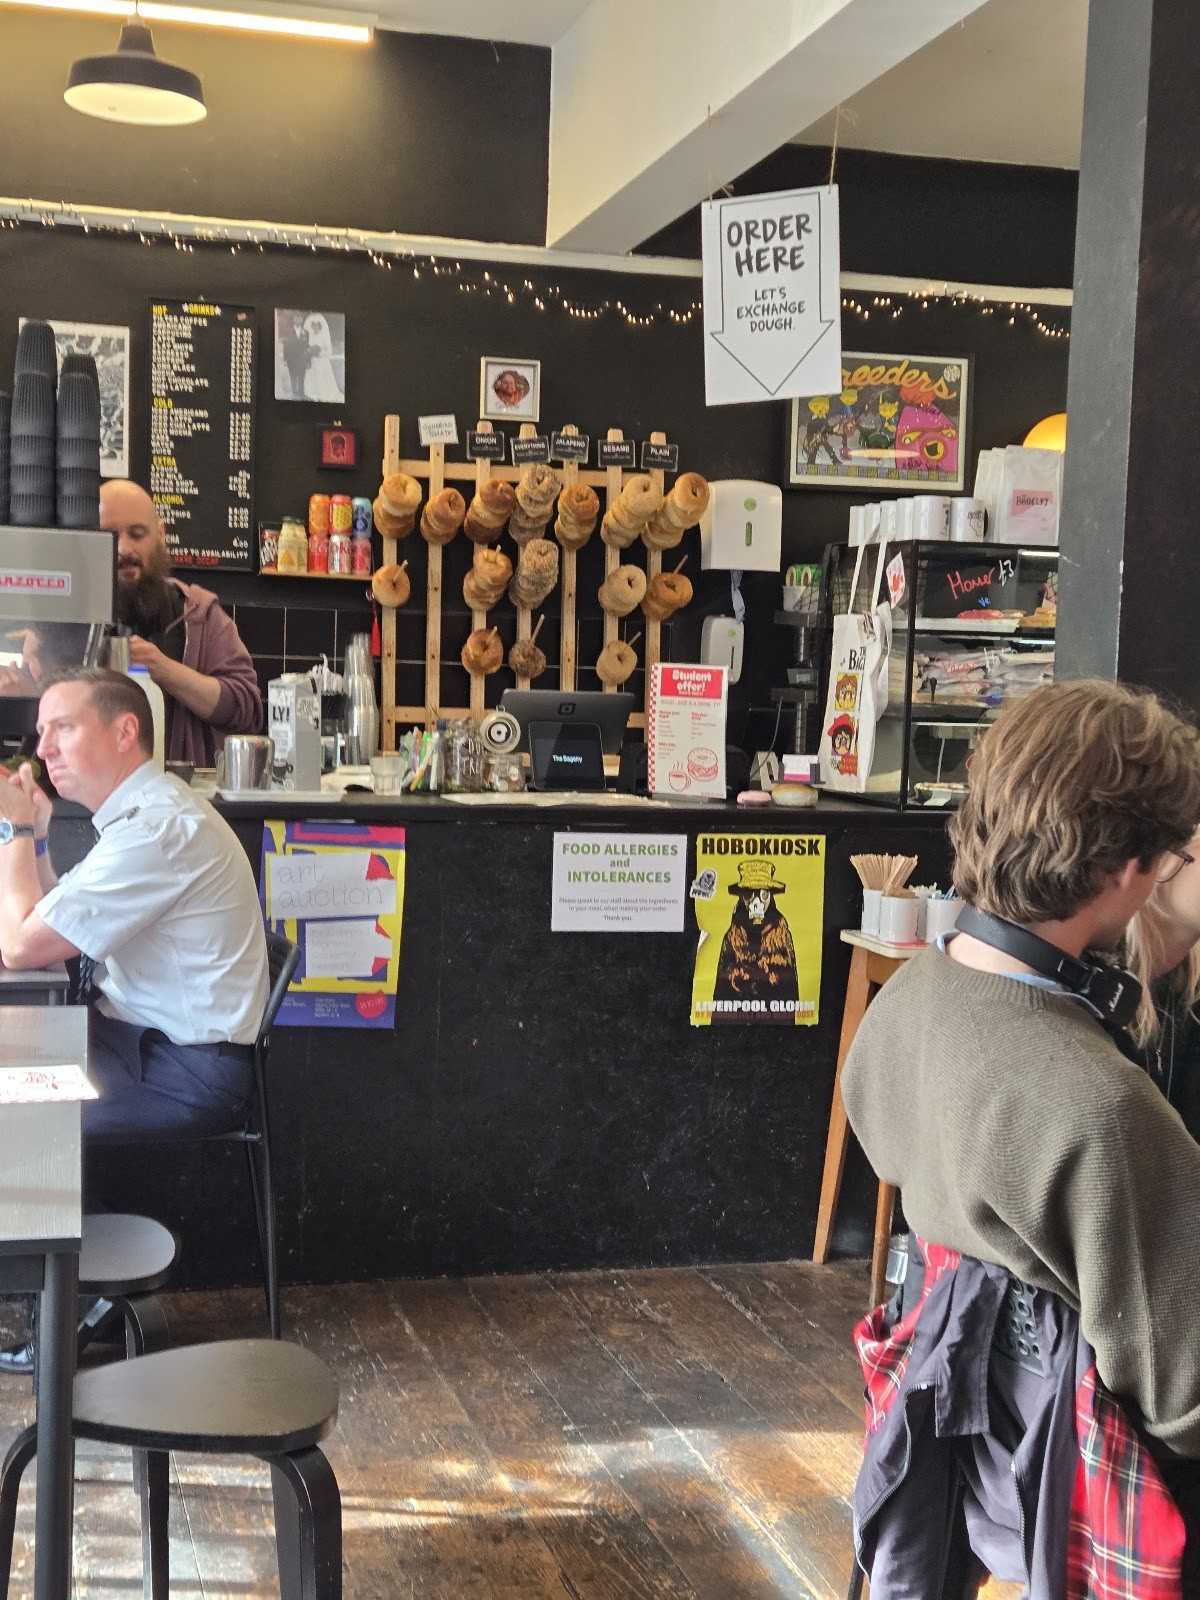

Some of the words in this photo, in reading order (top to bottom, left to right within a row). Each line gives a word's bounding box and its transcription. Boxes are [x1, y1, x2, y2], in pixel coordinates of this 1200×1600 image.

[727, 213, 812, 248] ORDER
[735, 245, 805, 278] HERE
[754, 286, 787, 303] LET'S
[152, 305, 167, 315] HOT
[189, 303, 215, 316] DRINKS
[736, 300, 806, 320] EXCHANGE
[180, 316, 207, 326] COFFEE
[750, 317, 796, 333] DOUGH.
[172, 362, 196, 372] BLACK
[168, 375, 209, 387] CHOCOLATE
[842, 359, 957, 400] reeders
[170, 383, 193, 392] LATTE
[154, 397, 172, 409] COLD
[169, 407, 209, 418] AMERICANO
[187, 421, 210, 431] LATTE
[169, 428, 192, 437] MOCHA
[476, 437, 497, 445] ONION
[603, 445, 630, 453] SESAME
[650, 448, 670, 456] PLAIN
[153, 455, 176, 467] EXTRA
[175, 486, 198, 495] CREAM
[153, 494, 184, 505] ALCOHOL
[190, 549, 200, 557] TO
[201, 550, 249, 559] AVAILABILITY
[998, 559, 1015, 587] £3
[672, 670, 712, 682] Student
[676, 681, 706, 692] offer!
[272, 706, 290, 722] LY!
[562, 843, 600, 855] FOOD
[604, 844, 678, 856] ALLERGIES
[702, 838, 820, 856] HOBOKIOSK
[610, 858, 630, 868] and
[277, 860, 325, 884] art
[568, 871, 672, 883] INTOLERANCES
[278, 883, 383, 908] auction
[695, 1000, 767, 1012] LIVERPOOL
